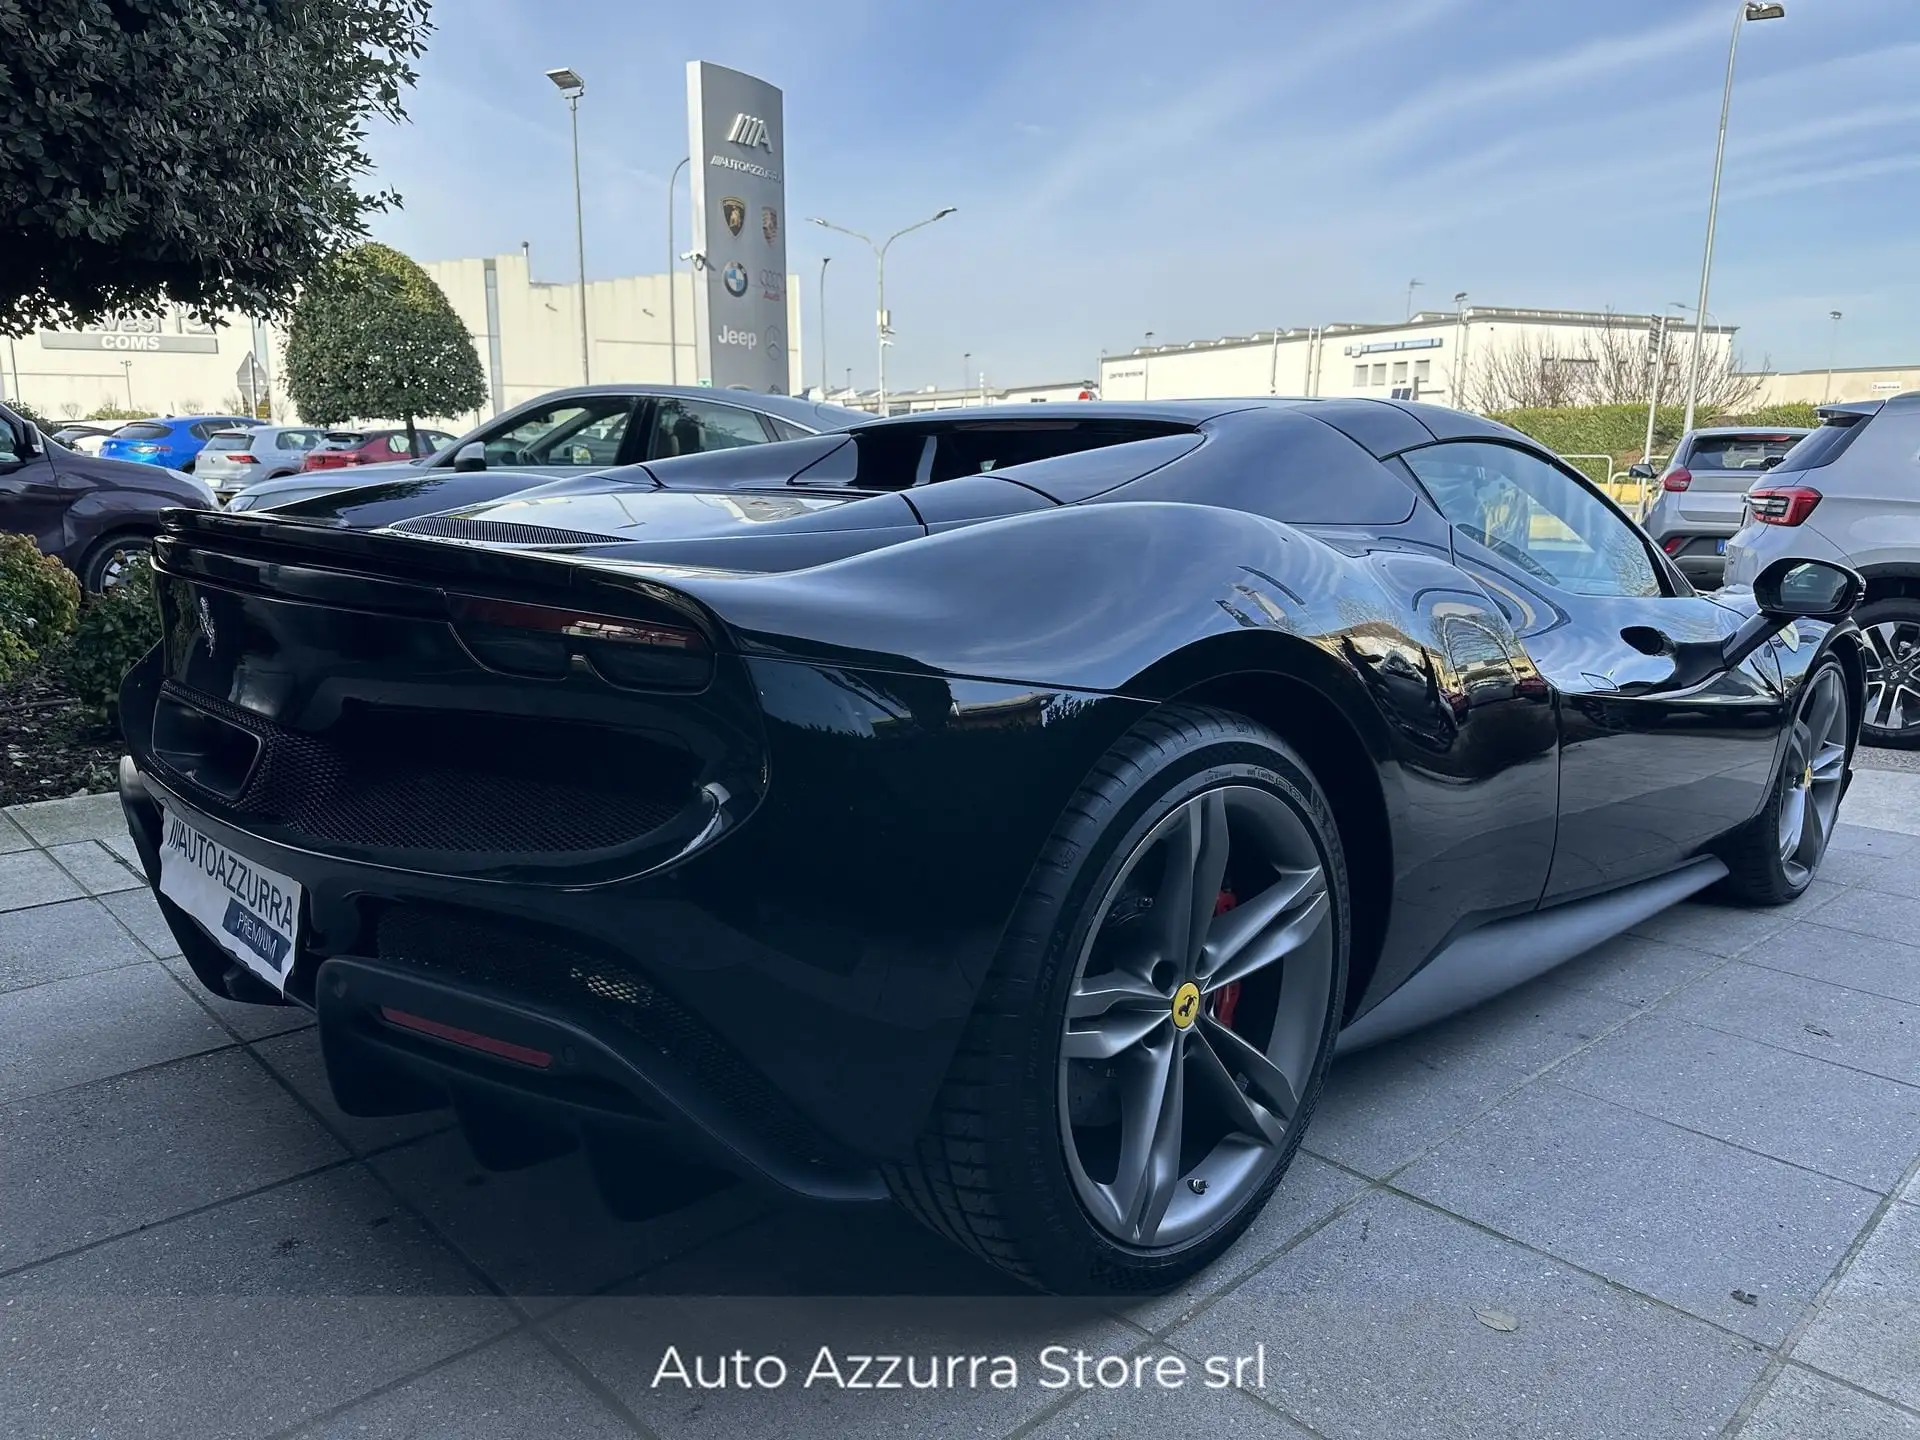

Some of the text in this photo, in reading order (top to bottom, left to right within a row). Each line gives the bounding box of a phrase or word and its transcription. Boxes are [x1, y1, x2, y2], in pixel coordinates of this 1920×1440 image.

[101, 335, 160, 350] COMS
[718, 325, 757, 350] Jeep
[237, 911, 278, 960] PREMIUM
